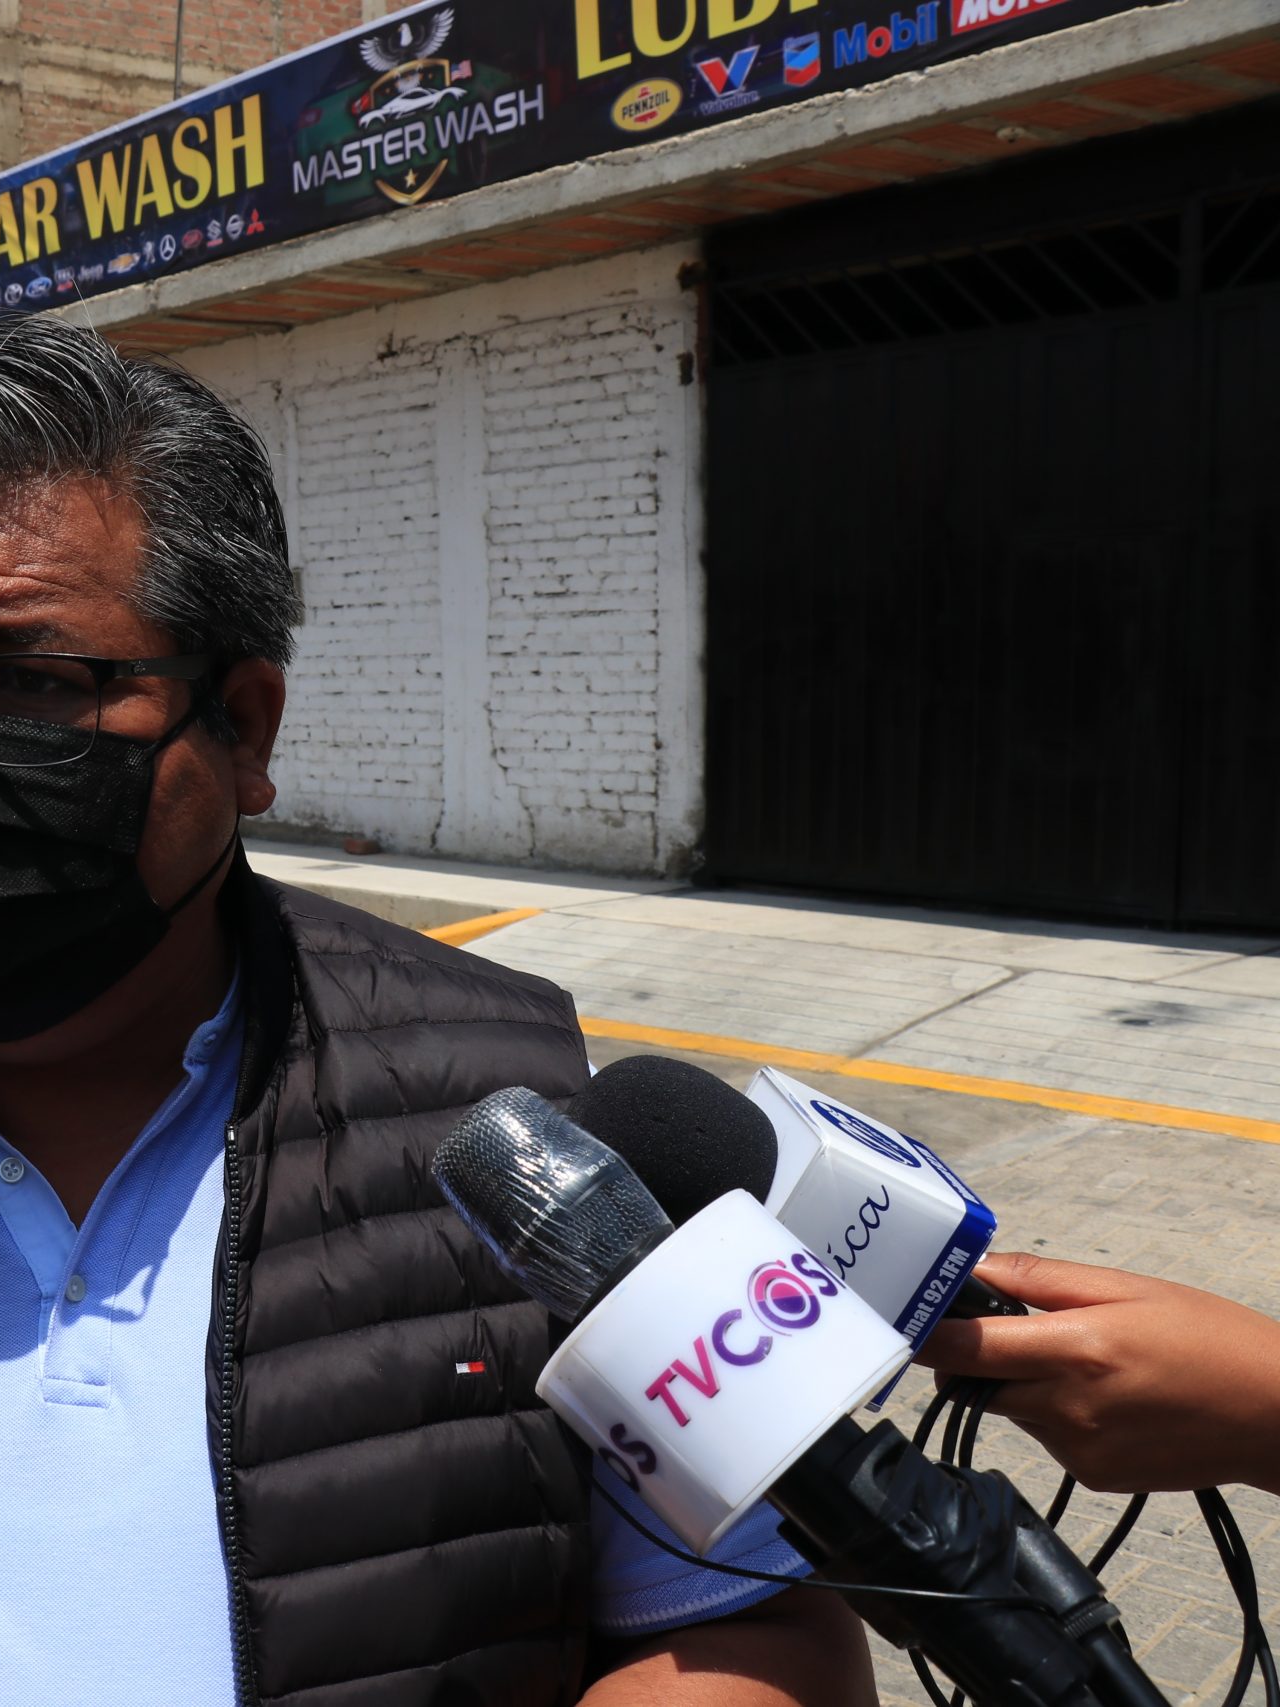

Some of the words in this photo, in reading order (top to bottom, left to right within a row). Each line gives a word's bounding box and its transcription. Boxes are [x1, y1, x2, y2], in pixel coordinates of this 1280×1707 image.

[833, 1, 939, 69] Mobil
[292, 121, 427, 194] MASTER
[434, 83, 545, 149] WASH
[621, 89, 671, 120] PENNZOIL
[76, 93, 264, 241] WASH
[584, 1163, 600, 1178] MD
[832, 1184, 891, 1281] ica
[922, 1246, 970, 1305] 92.1FM
